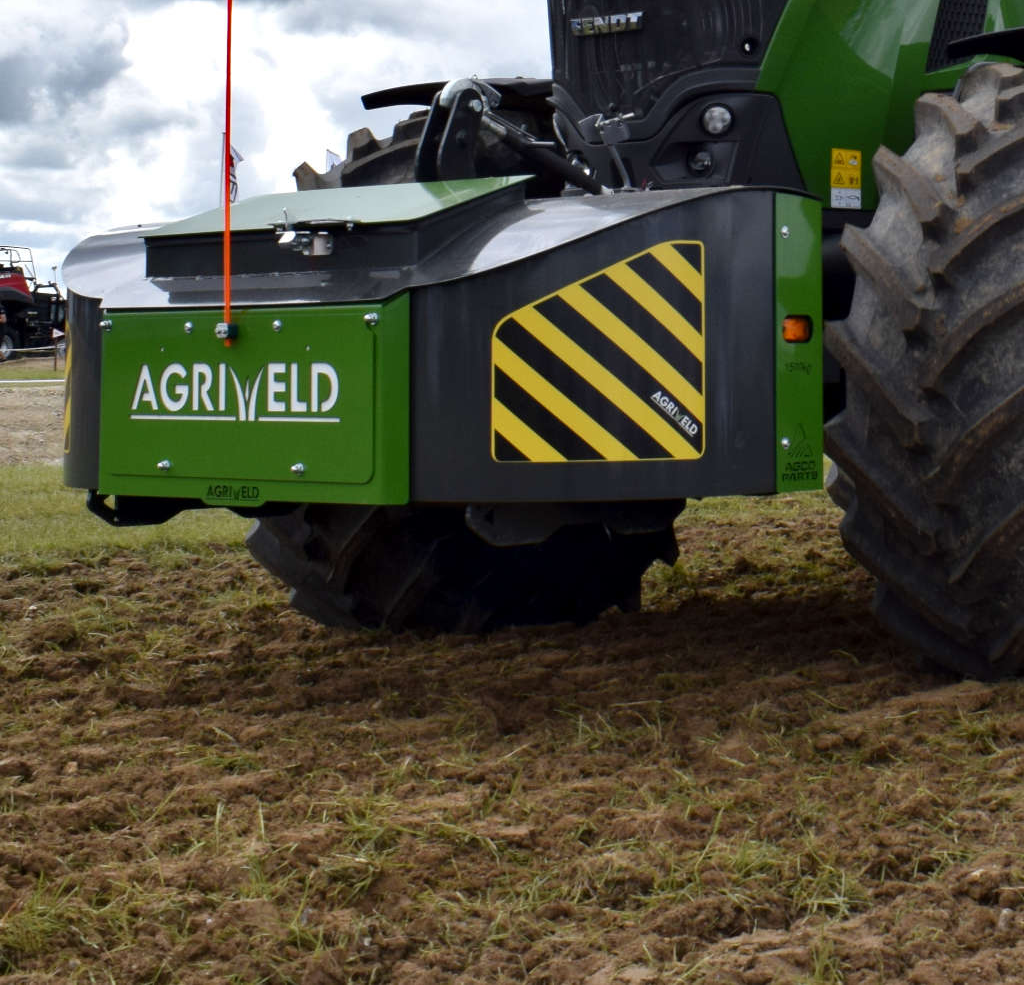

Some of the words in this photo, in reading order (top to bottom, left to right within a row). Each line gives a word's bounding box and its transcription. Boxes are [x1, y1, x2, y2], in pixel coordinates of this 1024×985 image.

[568, 11, 645, 35] FENDT
[131, 363, 340, 422] AGRIWELD
[650, 390, 699, 436] AGRIWELD
